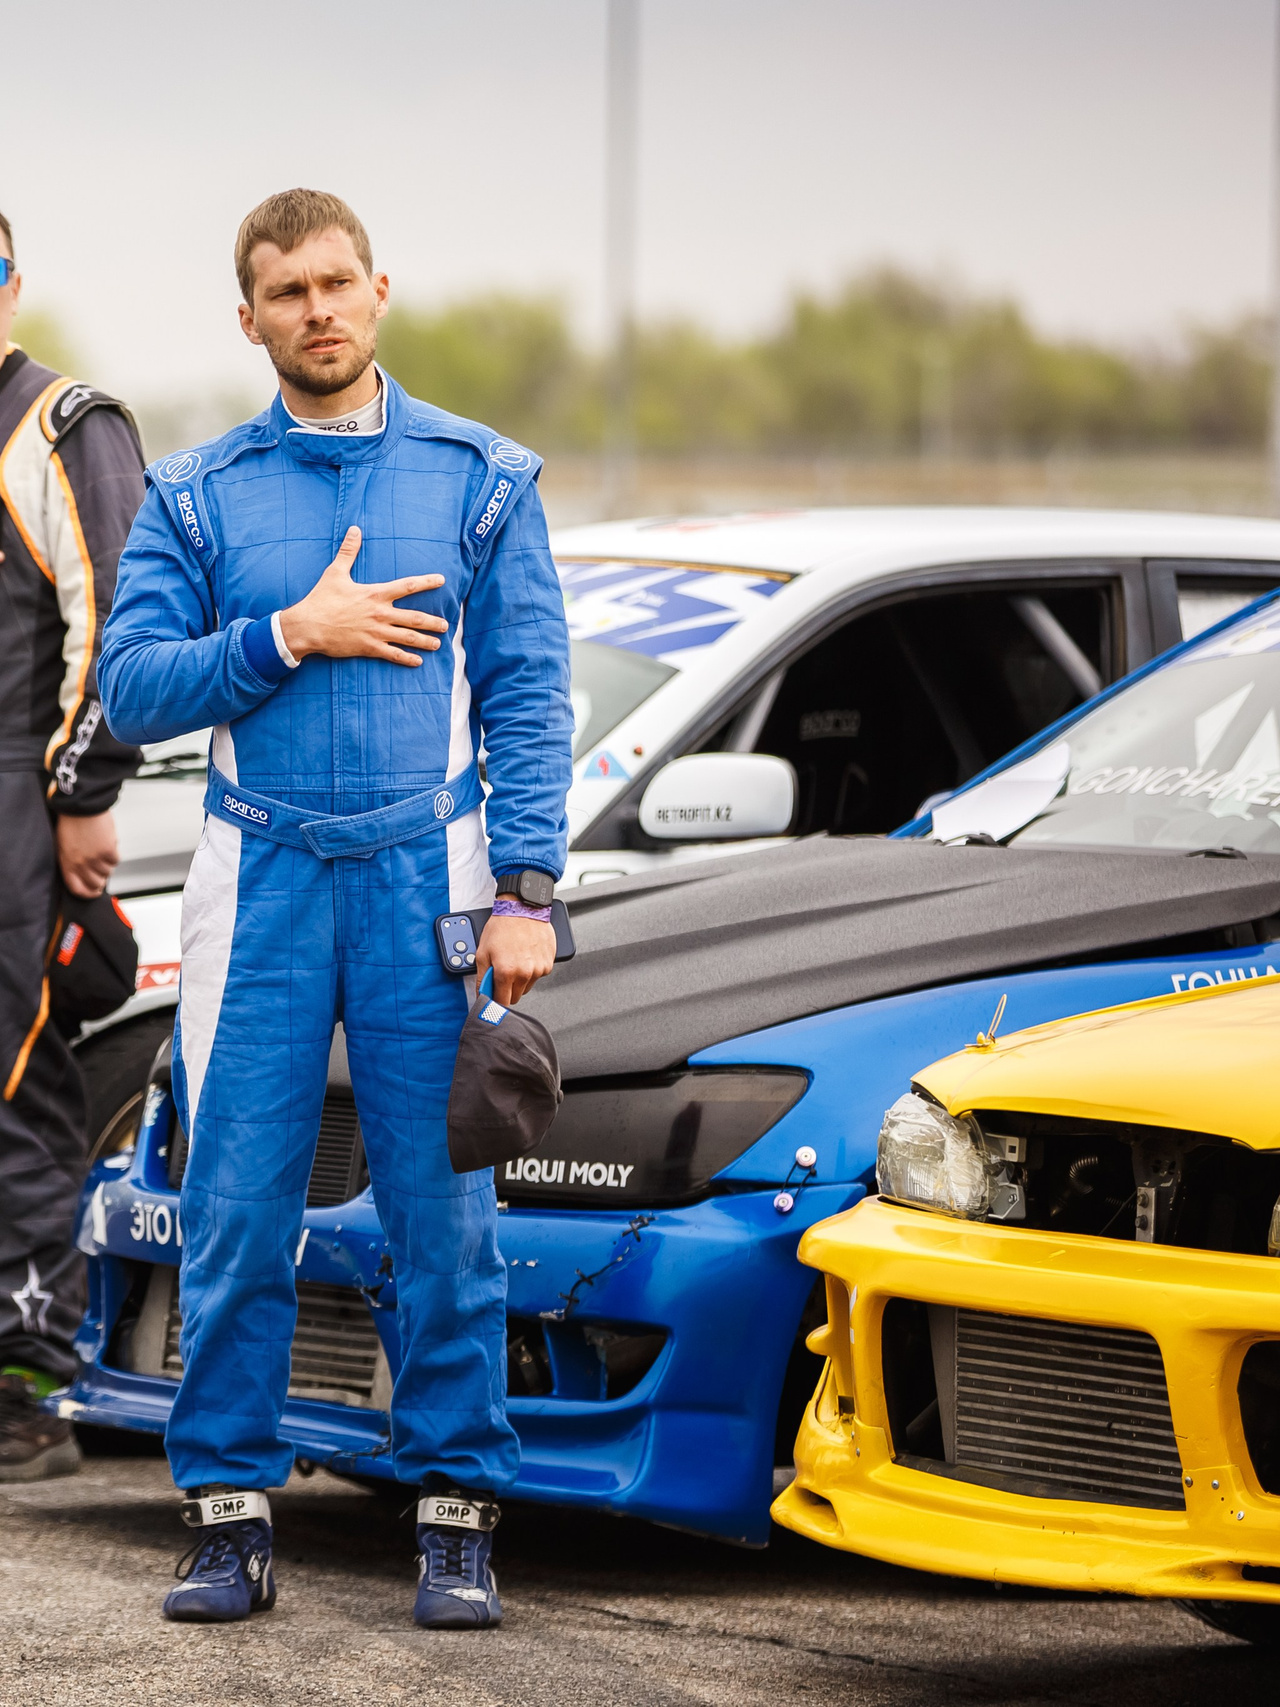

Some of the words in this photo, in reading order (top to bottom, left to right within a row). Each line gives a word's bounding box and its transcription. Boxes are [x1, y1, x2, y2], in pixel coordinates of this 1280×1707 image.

[176, 491, 204, 549] sparco
[475, 479, 511, 538] sparco
[222, 794, 268, 824] sparco
[505, 1157, 566, 1184] LIQUI
[568, 1161, 634, 1188] MOLY
[211, 1500, 245, 1516] OMP
[435, 1504, 470, 1520] OMP
